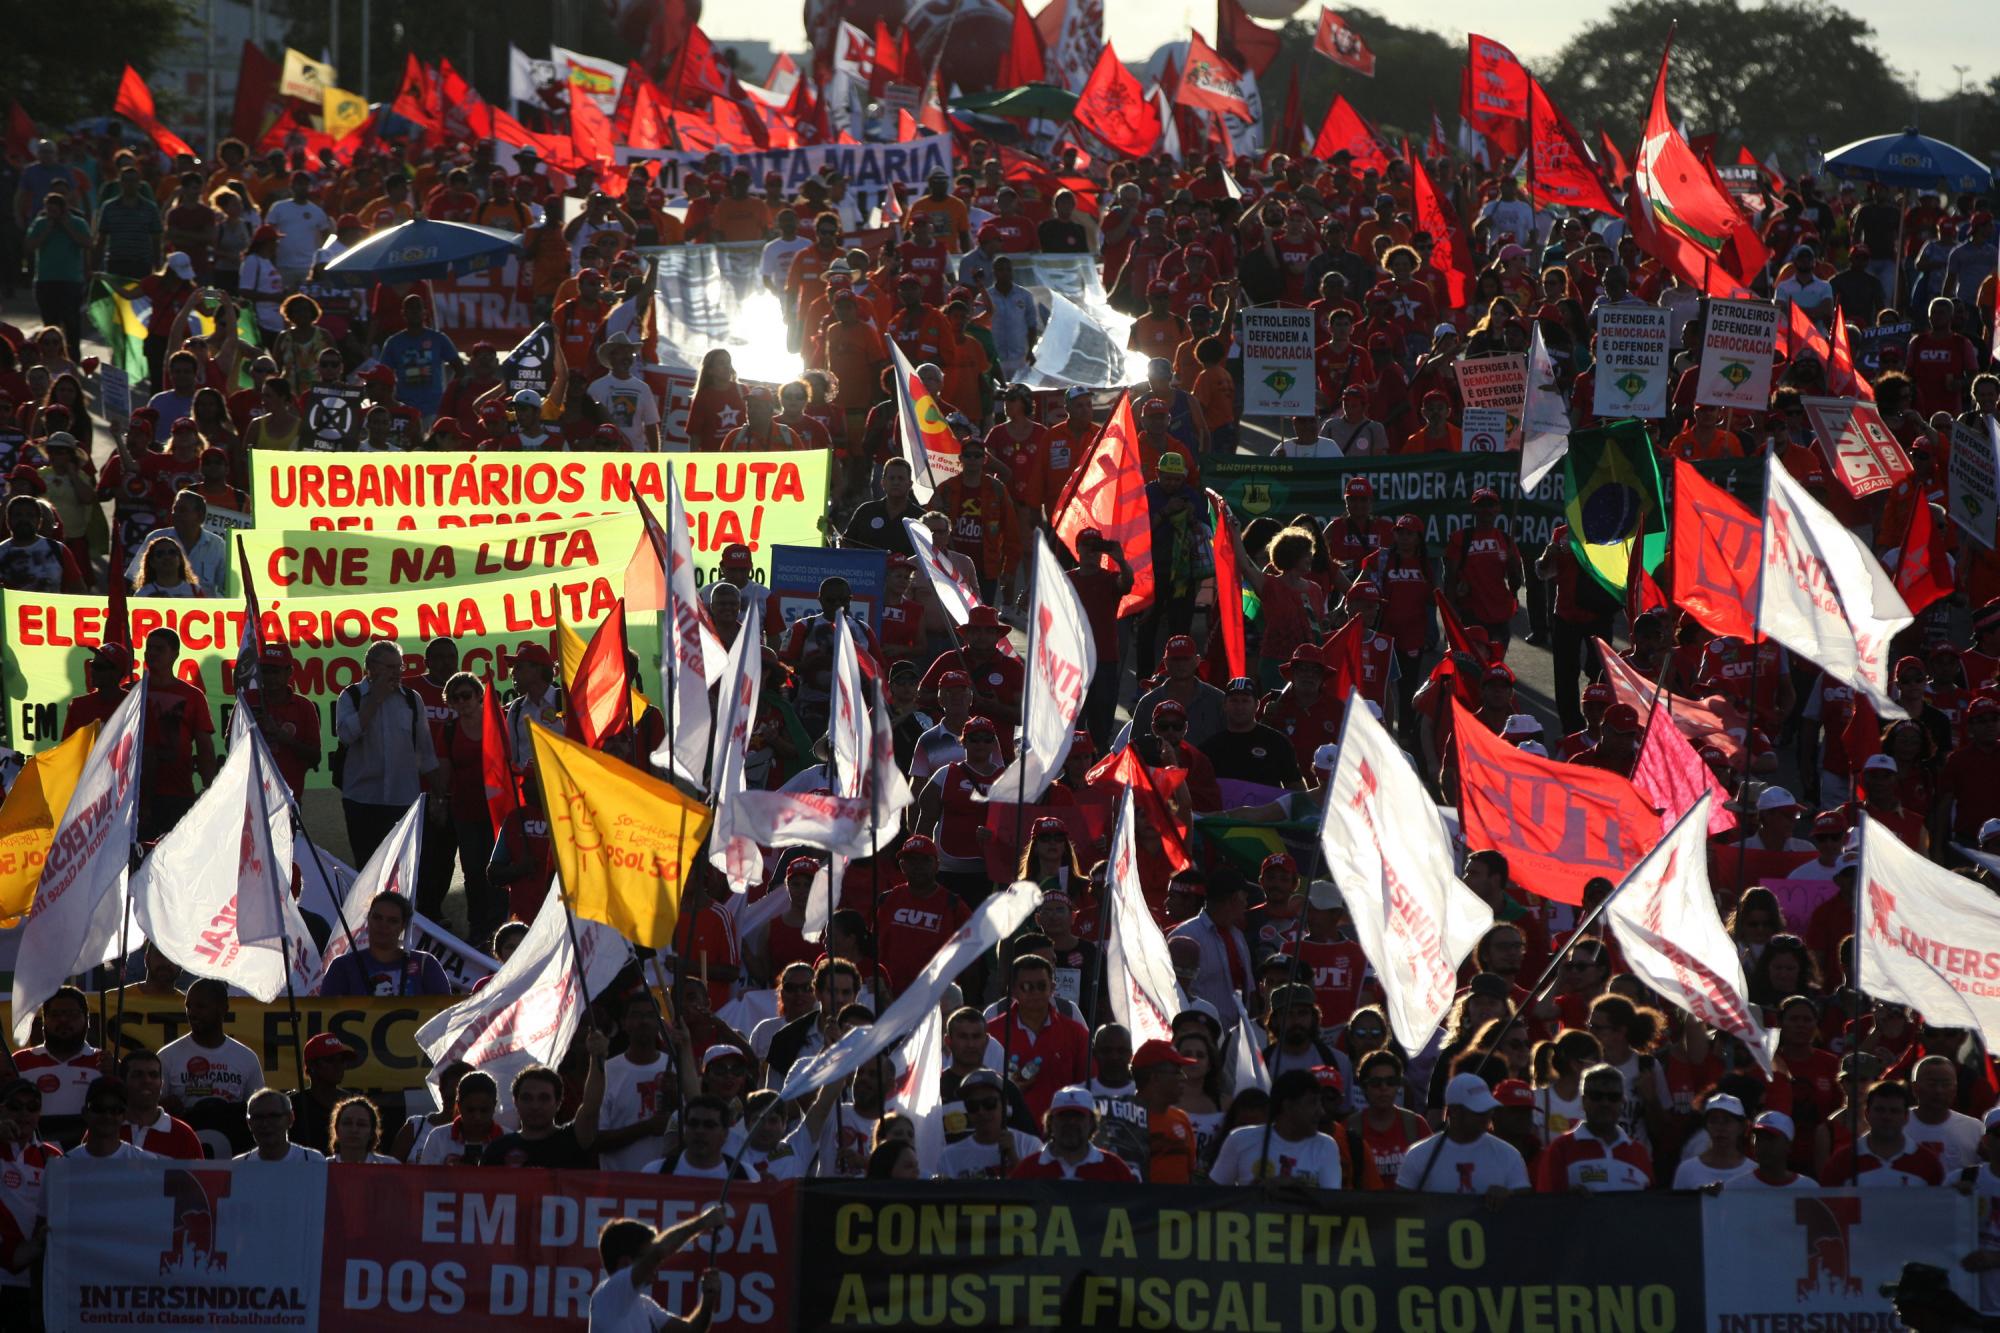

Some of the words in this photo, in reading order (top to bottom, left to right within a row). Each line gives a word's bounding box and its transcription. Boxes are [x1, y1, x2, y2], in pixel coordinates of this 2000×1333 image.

[824, 143, 949, 188] MARIA
[1246, 314, 1310, 328] PETROLEIROS
[1603, 313, 1656, 325] DEFENDER
[1658, 316, 1665, 325] A
[1712, 304, 1775, 323] PETROLEIROS
[1249, 329, 1300, 342] DEFENDEM
[1301, 330, 1309, 341] A
[1601, 327, 1666, 339] DEMOCRACIA
[1711, 320, 1762, 335] DEFENDEM
[1762, 325, 1771, 336] A
[1247, 343, 1312, 360] DEMOCRACIA
[1612, 341, 1664, 352] DEFENDER
[1707, 334, 1773, 356] DEMOCRACIA
[1462, 361, 1509, 376] DEFENDER
[1513, 361, 1519, 369] A
[1606, 354, 1614, 363] O
[1615, 351, 1660, 366] PRÉ-SAL!
[1463, 372, 1523, 387] DEMOCRACIA
[1476, 384, 1525, 398] DEFENDER
[269, 455, 585, 508] URBANITÁRIOS
[601, 461, 665, 502] NA
[684, 461, 805, 503] LUTA
[1452, 472, 1466, 500] A
[1425, 513, 1440, 543] A
[267, 546, 369, 587] CNE
[389, 547, 457, 584] NA
[475, 529, 600, 575] LUTA
[18, 601, 399, 651] ELERICITÁRIOS
[417, 597, 487, 643] NA
[504, 576, 618, 633] LUTA
[23, 703, 58, 742] EM
[523, 819, 548, 836] CU
[607, 844, 645, 873] PSOL
[648, 855, 682, 881] 50
[893, 907, 939, 929] CUT
[1313, 967, 1346, 986] UT
[422, 1191, 516, 1247] EM
[835, 1203, 1081, 1259] CONTRA
[1100, 1208, 1138, 1260] A
[1158, 1210, 1377, 1268] DIREITA
[1396, 1218, 1429, 1269] E
[1448, 1218, 1487, 1271] O
[343, 1259, 468, 1311] DOS
[80, 1286, 306, 1311] INTERSINDICAL
[829, 1273, 1062, 1326] AJUSTE
[1080, 1276, 1282, 1333] FISCAL
[1301, 1283, 1377, 1333] DO
[1399, 1283, 1677, 1333] GOVERNO
[80, 1311, 135, 1324] Central
[136, 1312, 155, 1324] da
[157, 1312, 205, 1325] Classe
[207, 1312, 306, 1326] Trabalhadora
[1718, 1312, 1900, 1333] INTERSINDIC
